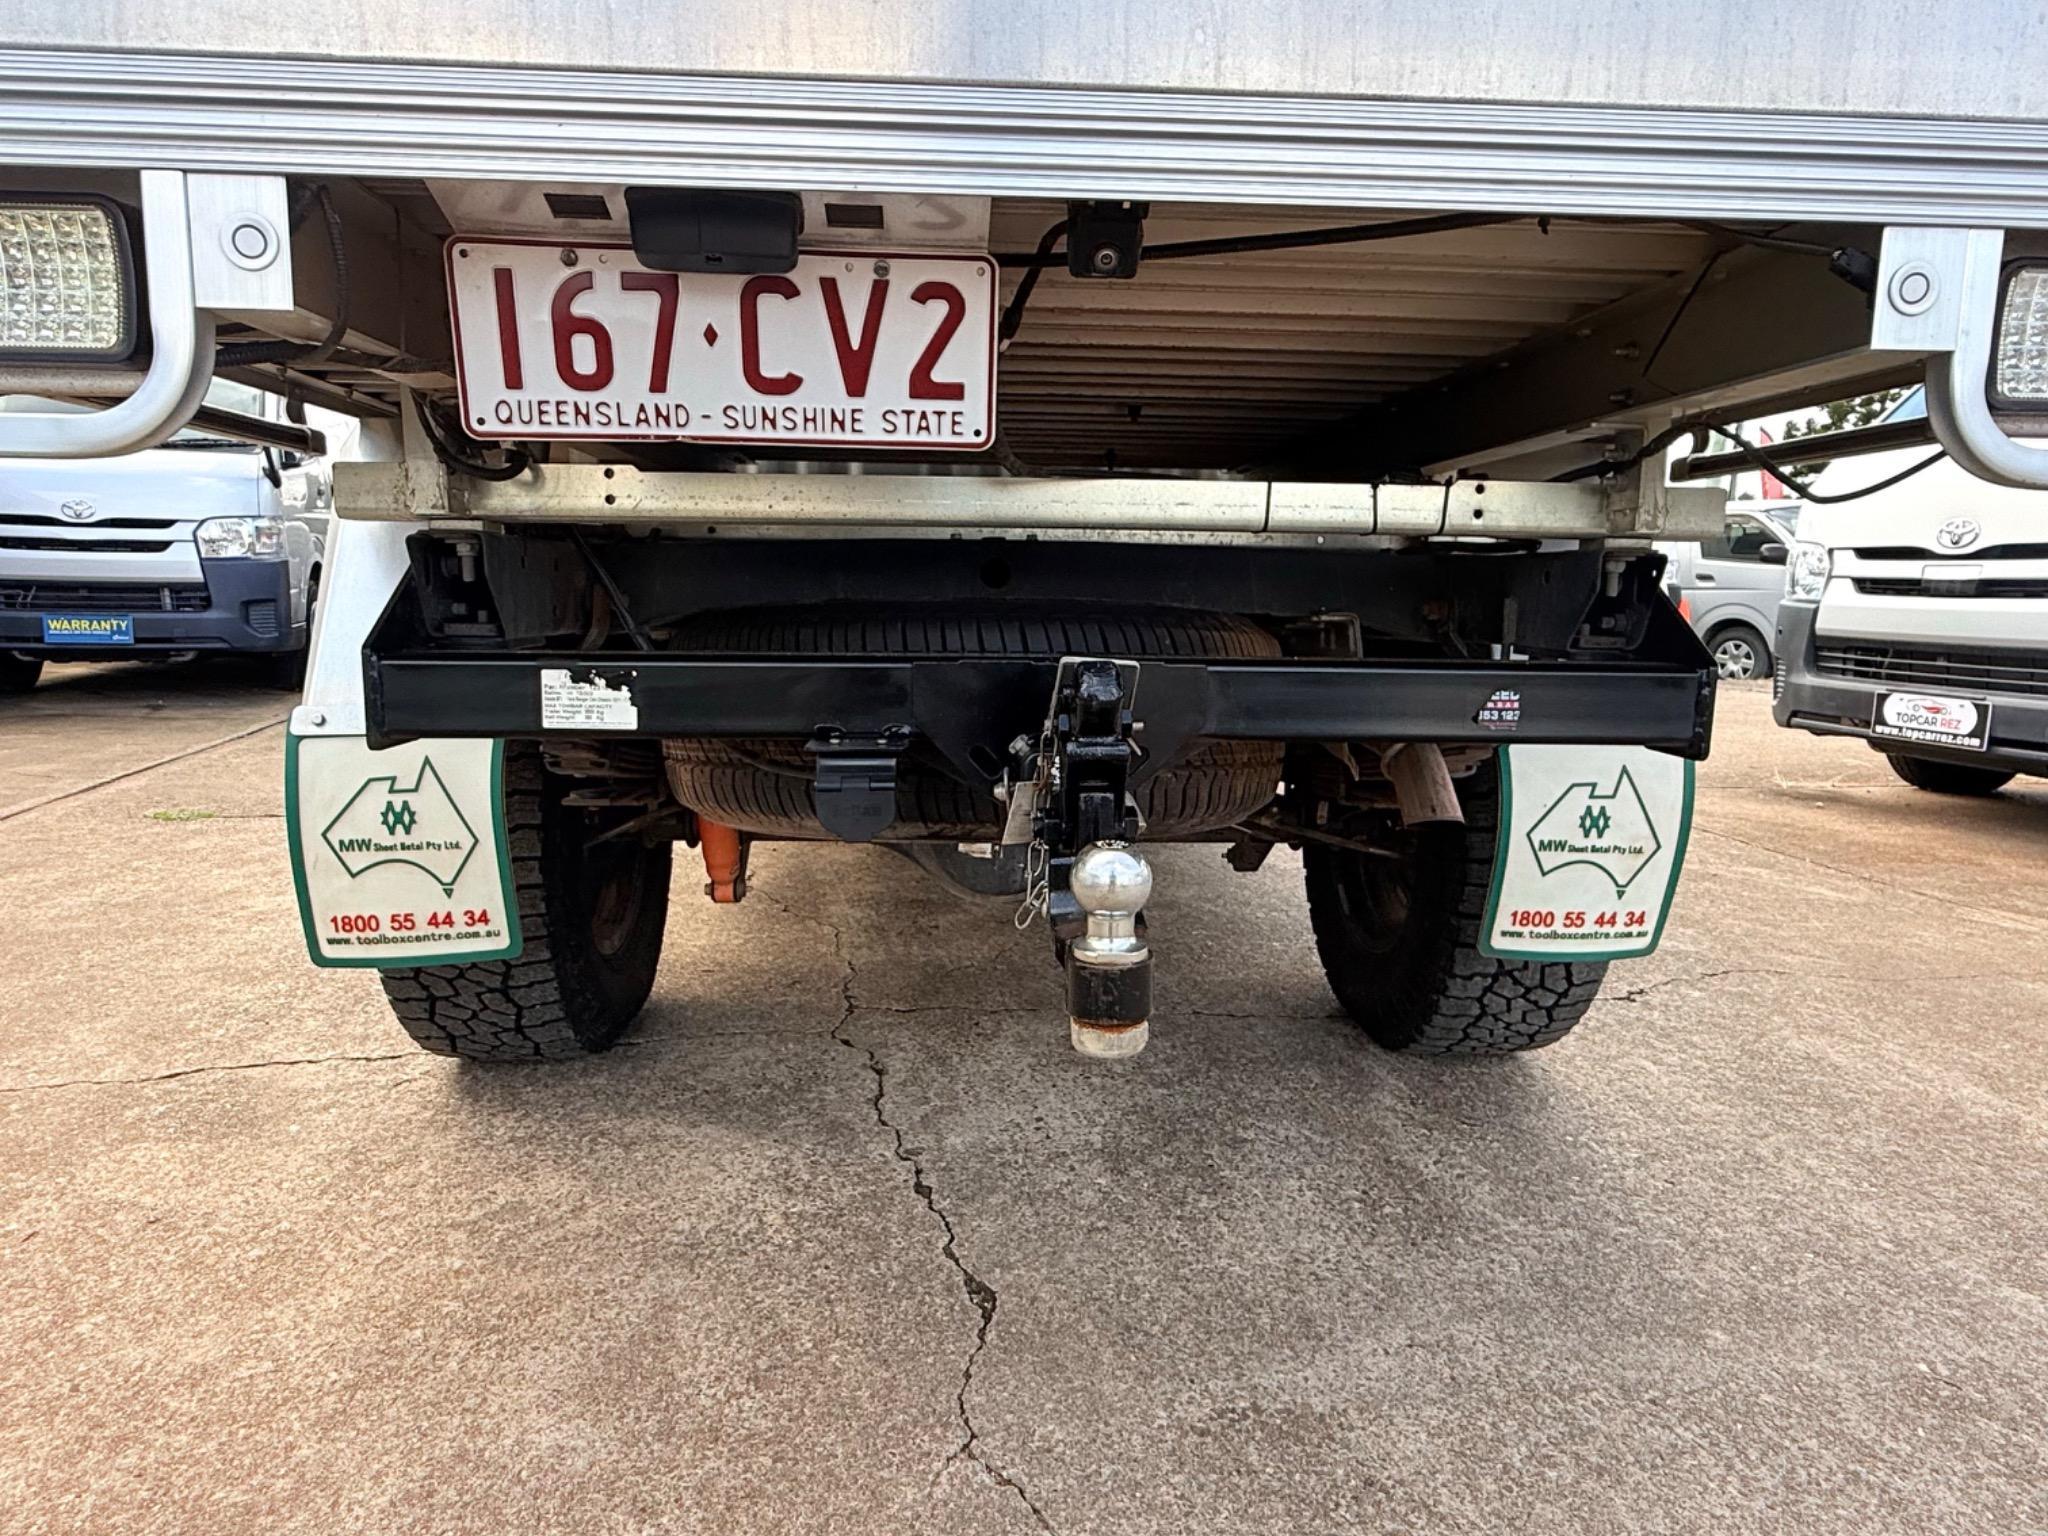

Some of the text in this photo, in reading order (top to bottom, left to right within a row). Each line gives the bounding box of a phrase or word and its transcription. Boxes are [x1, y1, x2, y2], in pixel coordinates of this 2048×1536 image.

[494, 268, 966, 400] 167 CV2
[494, 400, 690, 429] QUEENSLAND
[724, 408, 864, 434] SUNSHINE
[882, 410, 965, 436] STATE
[48, 619, 128, 631] WARRANTY
[1896, 712, 1962, 730] TOPCAR REZ
[1875, 724, 1981, 747] www.topcarrez.com
[338, 839, 372, 852] MW
[426, 841, 442, 852] Pty
[1538, 839, 1568, 852] MW
[1612, 845, 1627, 855] Pty
[330, 909, 490, 933] 1800 55 44 34
[1510, 910, 1646, 928] 1800 55 44 34
